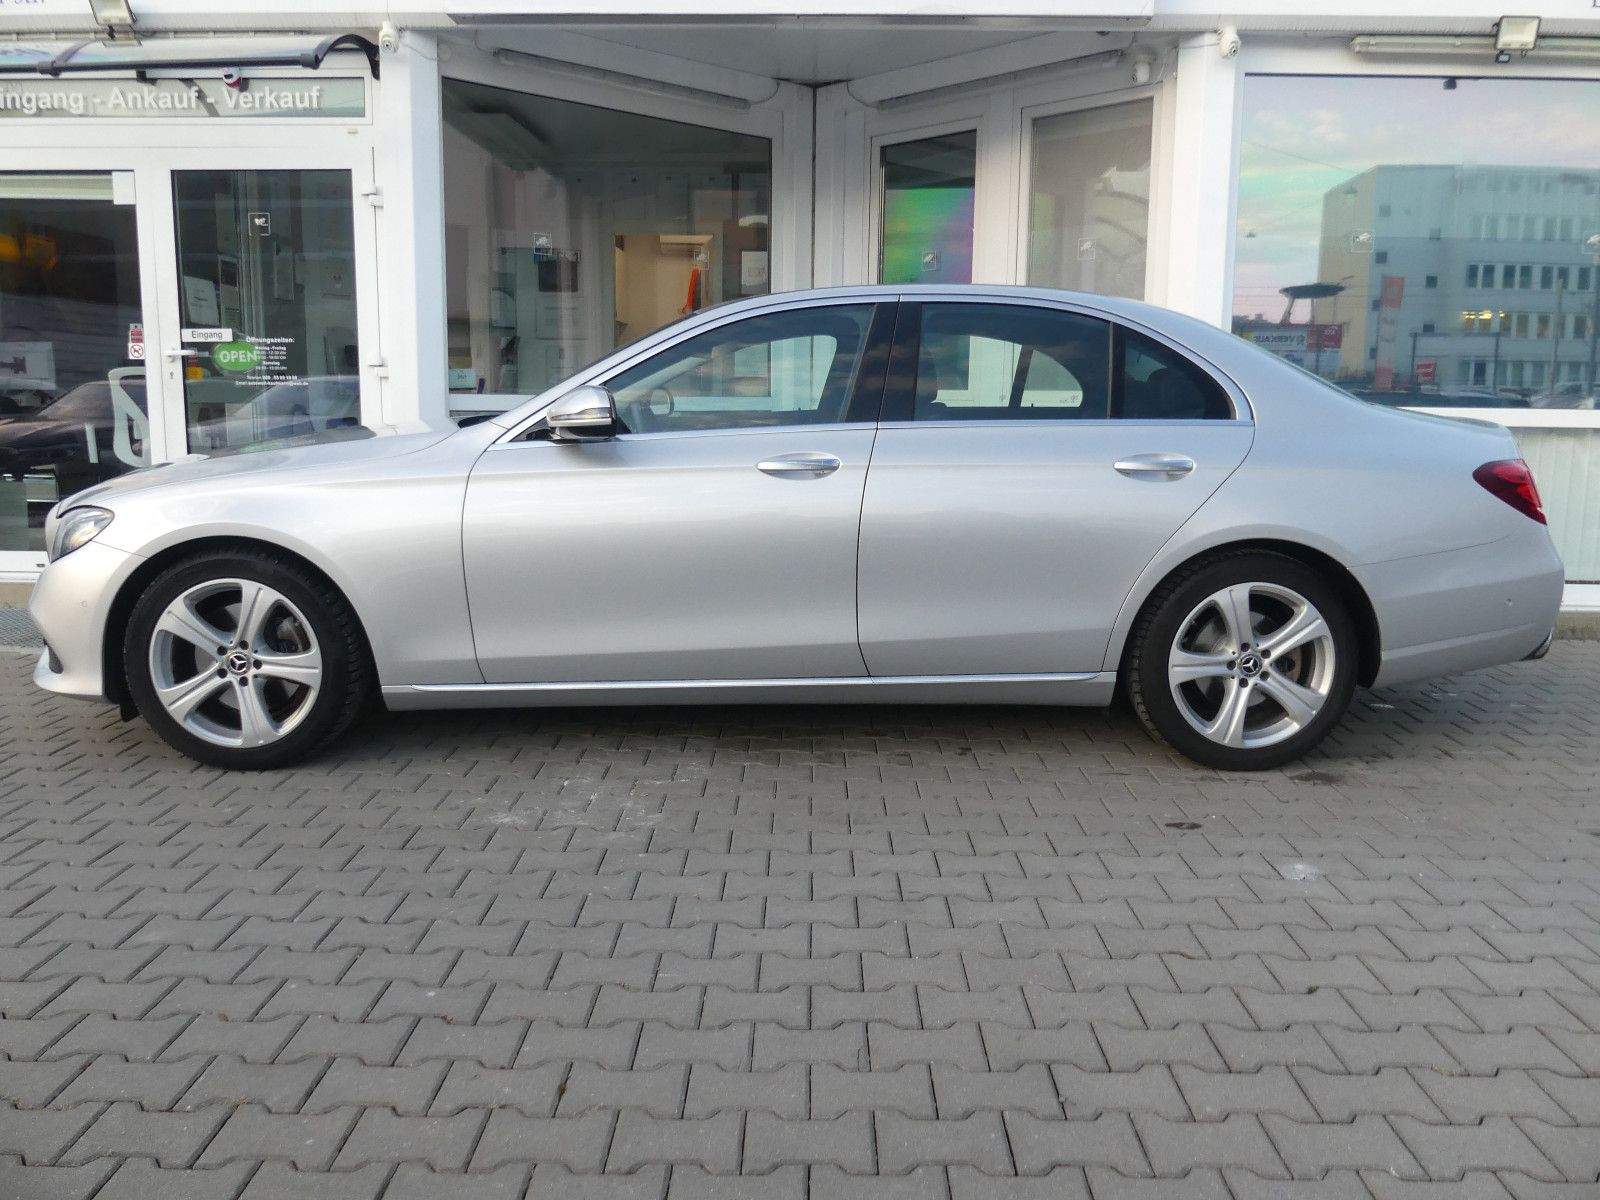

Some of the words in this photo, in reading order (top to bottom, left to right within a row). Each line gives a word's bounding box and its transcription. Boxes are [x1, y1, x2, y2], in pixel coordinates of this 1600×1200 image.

[109, 87, 201, 110] Ankauf
[223, 86, 321, 110] Verkauf
[191, 330, 223, 340] Eingang
[220, 351, 257, 362] OPEN
